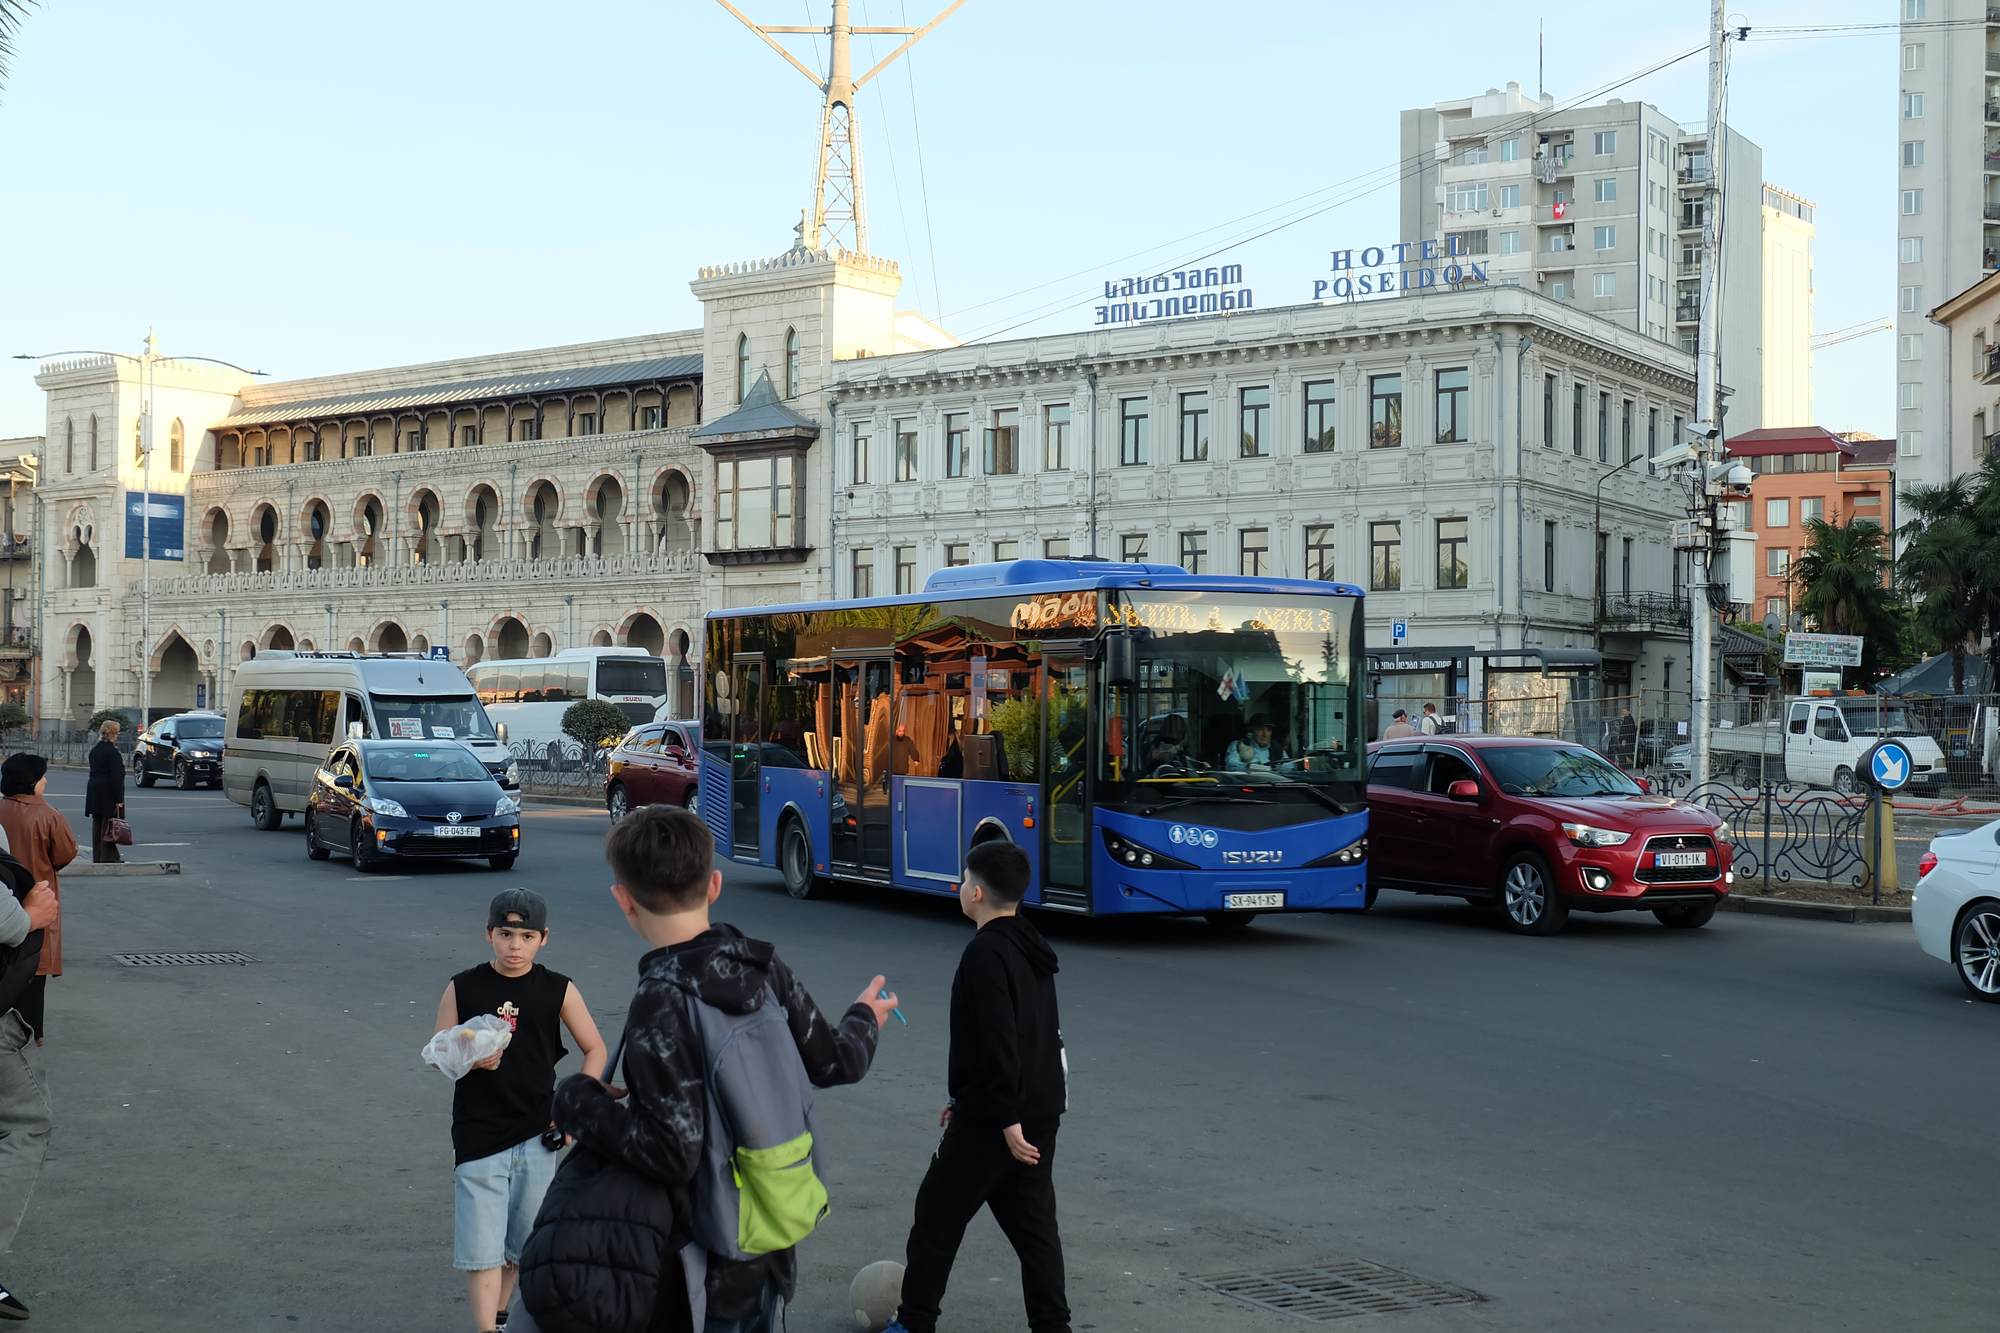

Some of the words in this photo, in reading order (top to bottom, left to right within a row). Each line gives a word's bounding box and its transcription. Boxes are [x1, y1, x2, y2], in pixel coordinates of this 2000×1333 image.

[1330, 235, 1470, 271] HOTEL
[1312, 260, 1490, 300] POSEIDON
[1395, 624, 1403, 636] P
[1222, 850, 1283, 864] ISUZU
[1661, 853, 1700, 865] VI-011-IK
